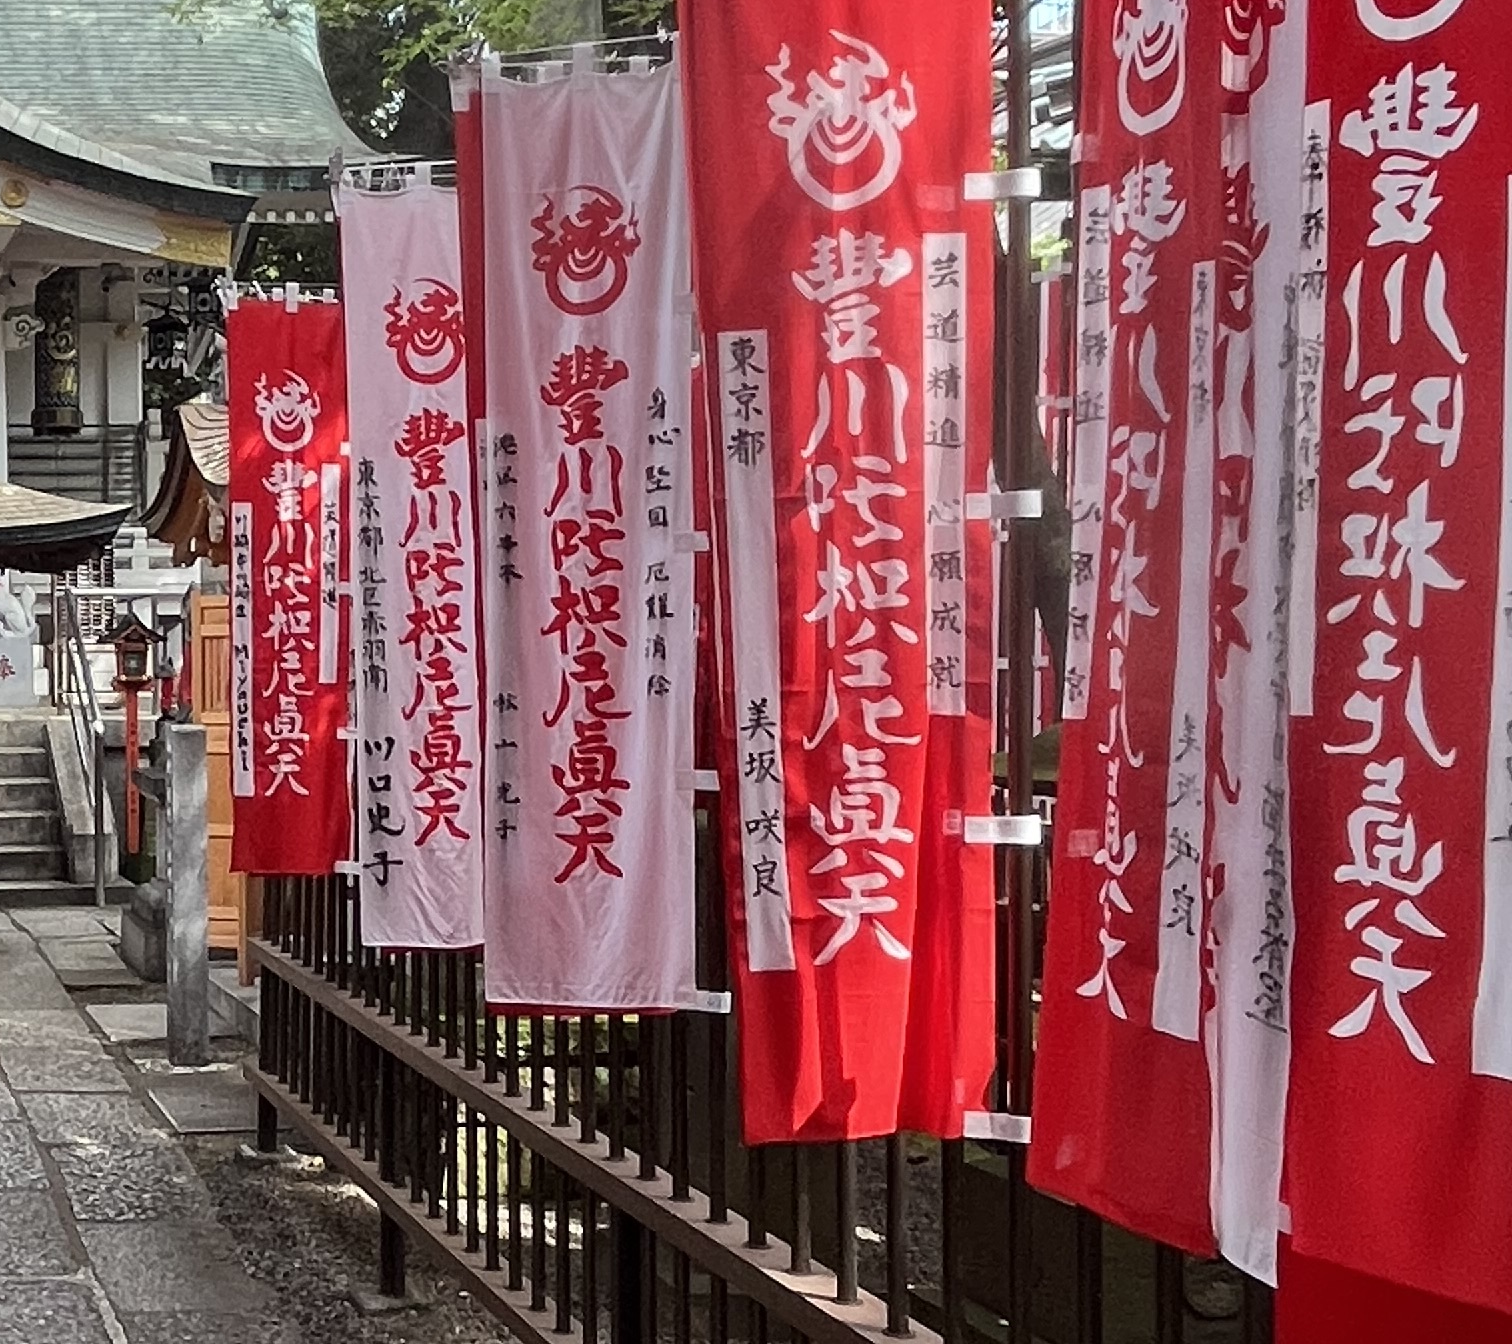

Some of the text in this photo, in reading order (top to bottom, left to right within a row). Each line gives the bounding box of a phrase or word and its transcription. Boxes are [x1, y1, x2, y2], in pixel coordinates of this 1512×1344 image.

[727, 339, 783, 897] 東京都 美坂咲良
[924, 252, 964, 688] 芸道精進 心願成就
